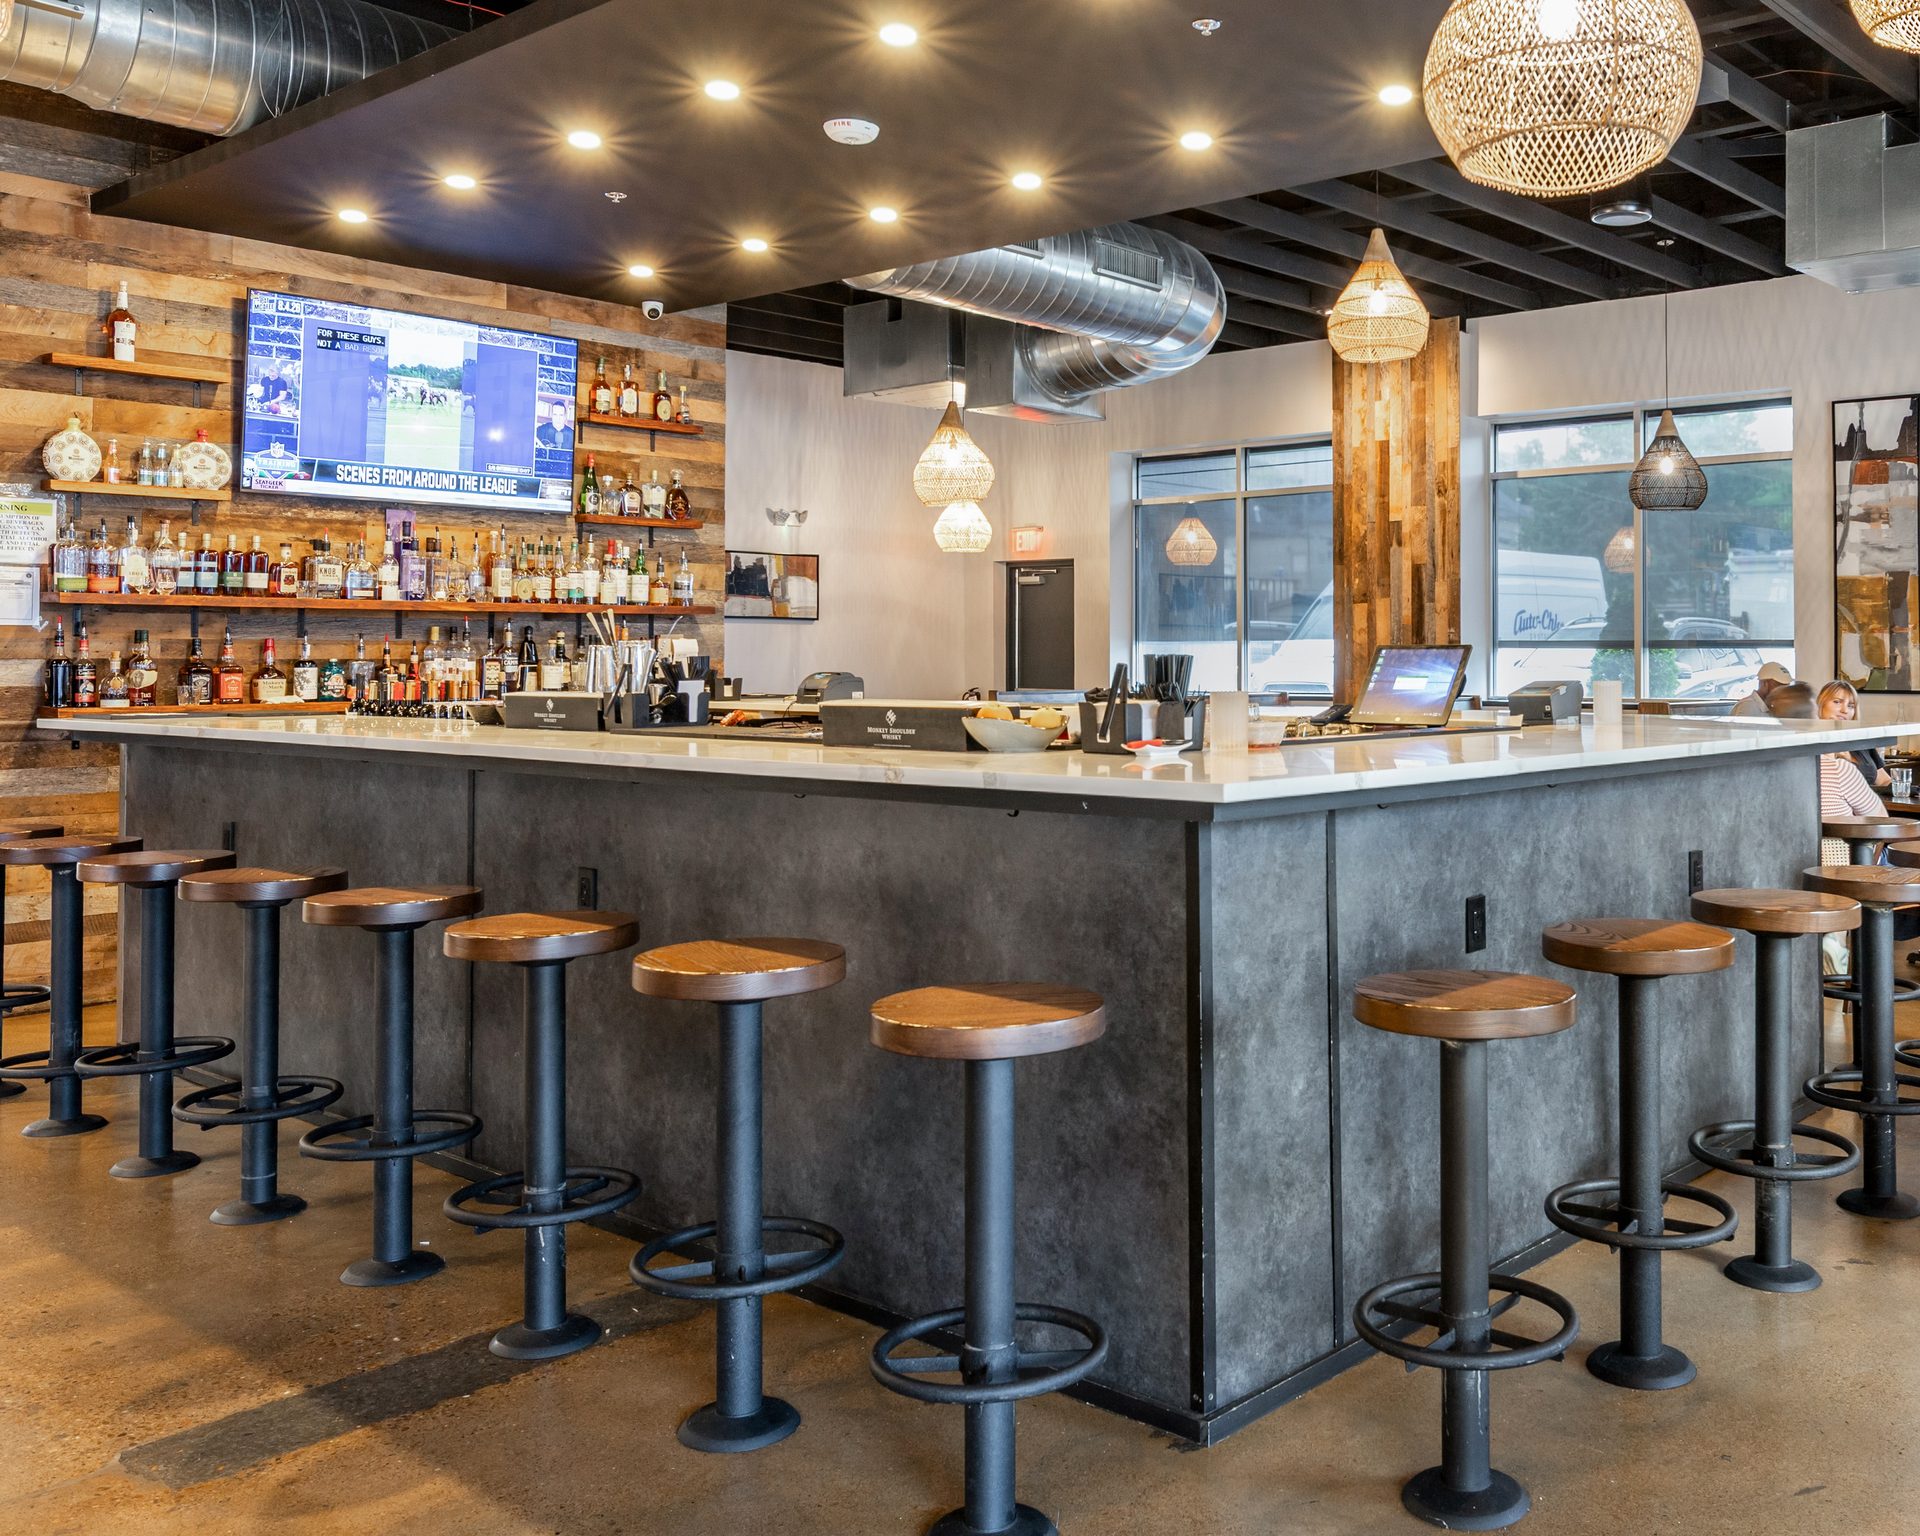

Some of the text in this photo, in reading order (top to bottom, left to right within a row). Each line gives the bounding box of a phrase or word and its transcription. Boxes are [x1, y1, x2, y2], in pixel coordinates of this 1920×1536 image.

[316, 339, 332, 349] NOT
[317, 328, 385, 345] FOR THESE GUYS.
[336, 464, 518, 495] SCENES FROM AROUND THE LEAGUE
[1015, 531, 1040, 552] EXIT
[319, 567, 336, 575] KNOB
